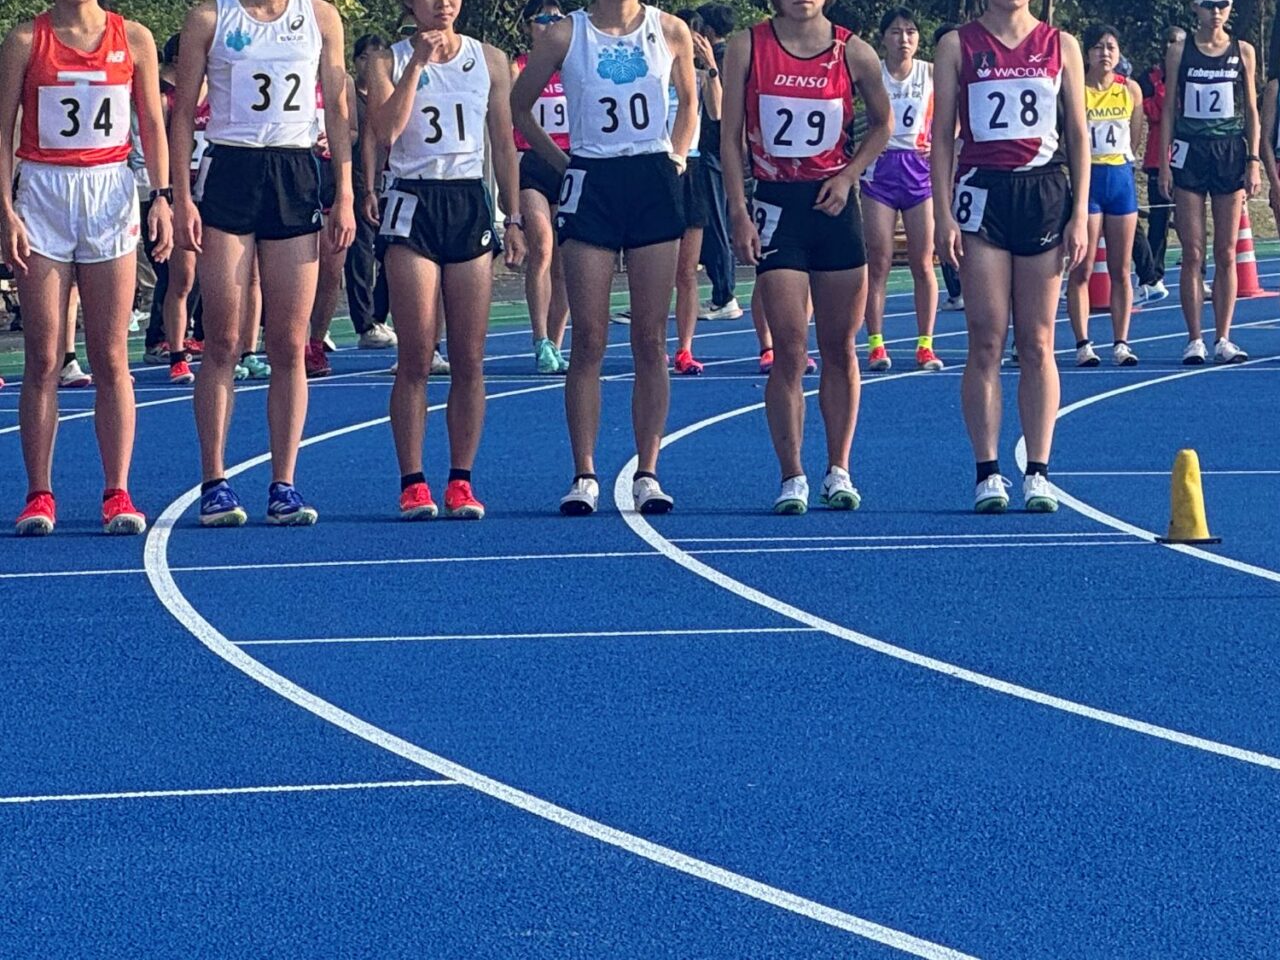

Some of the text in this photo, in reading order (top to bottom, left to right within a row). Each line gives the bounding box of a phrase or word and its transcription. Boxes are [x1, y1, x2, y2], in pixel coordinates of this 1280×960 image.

[774, 74, 828, 88] DENSO
[994, 67, 1049, 78] WACOAL
[251, 73, 300, 111] 32
[987, 89, 1039, 130] 28
[1196, 90, 1221, 113] 12
[60, 97, 113, 137] 34
[421, 103, 465, 144] 31
[540, 103, 565, 127] 19
[599, 92, 649, 133] 30
[773, 108, 826, 146] 29
[1091, 125, 1116, 148] 14
